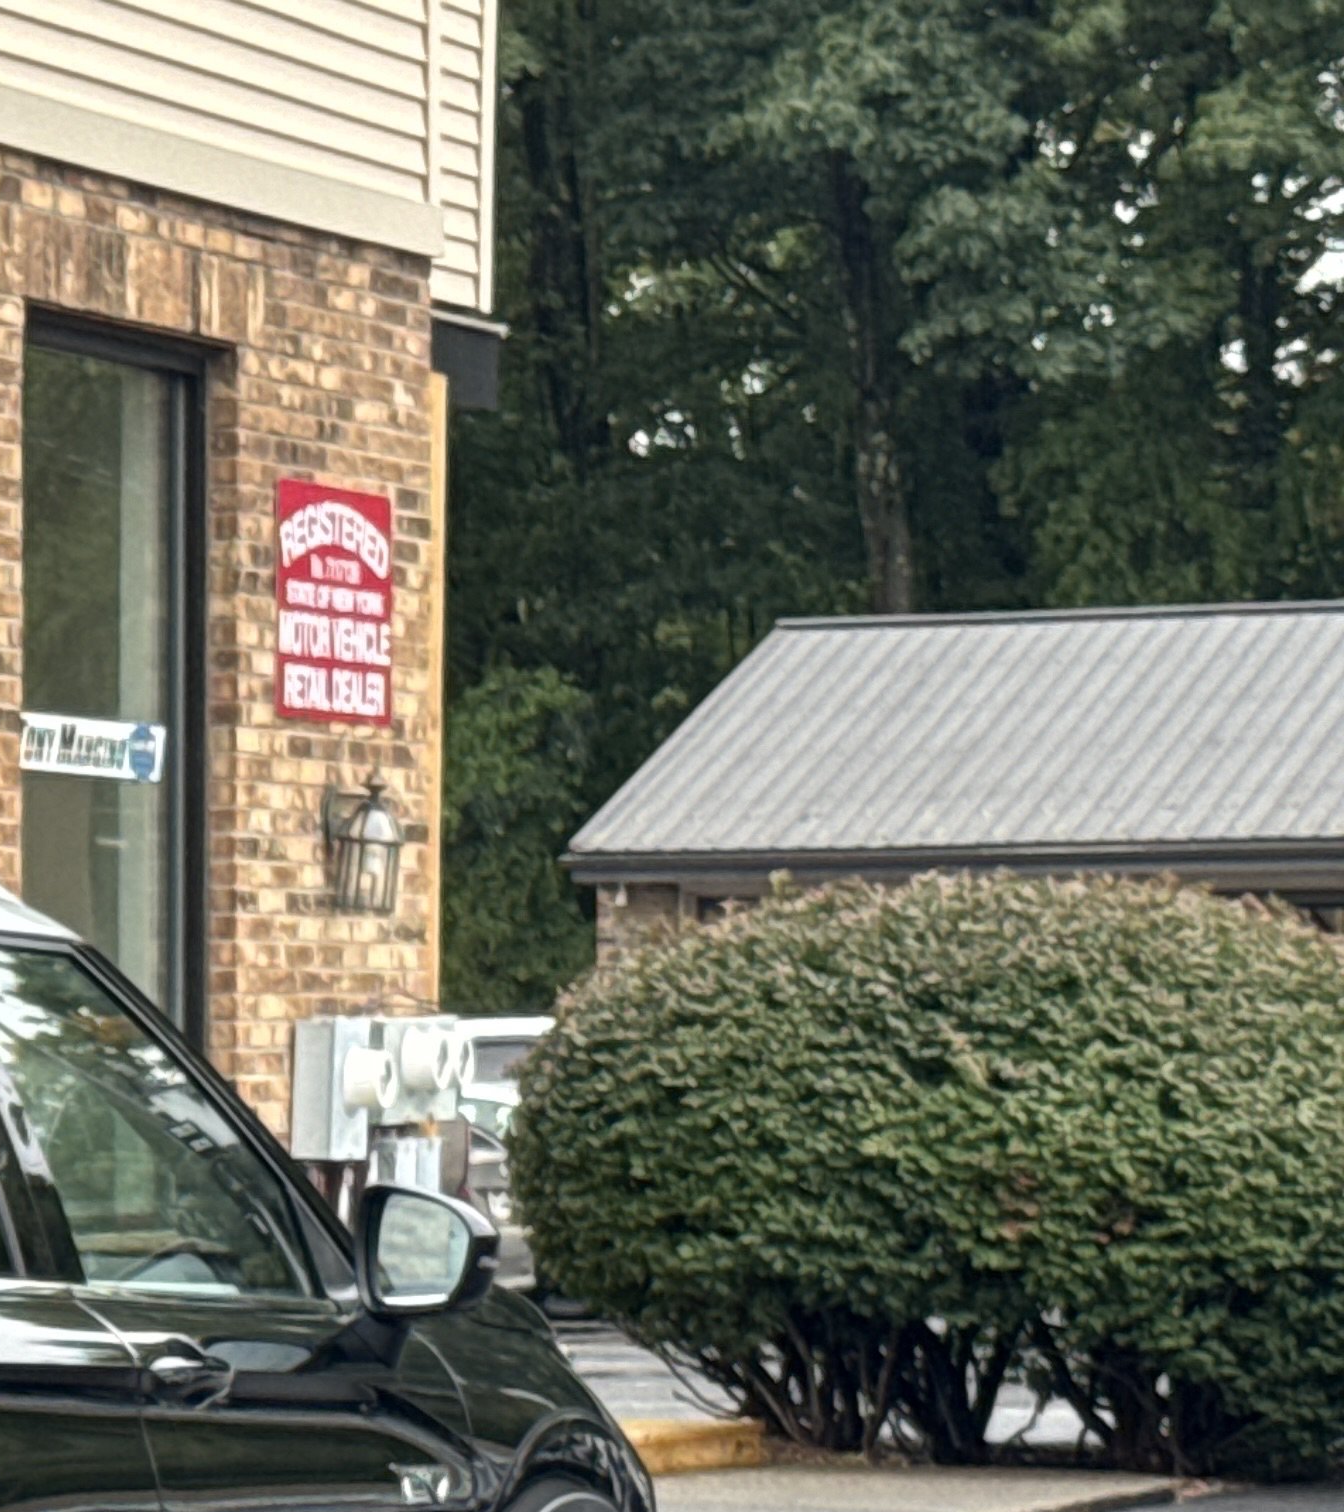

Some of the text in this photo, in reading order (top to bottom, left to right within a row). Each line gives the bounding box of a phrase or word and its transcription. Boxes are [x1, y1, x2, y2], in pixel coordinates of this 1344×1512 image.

[279, 500, 390, 581] REGISTERED
[278, 609, 392, 666] MOTOR VEHICLE
[283, 662, 386, 717] RETAIL DEALER
[23, 726, 56, 763] ONY
